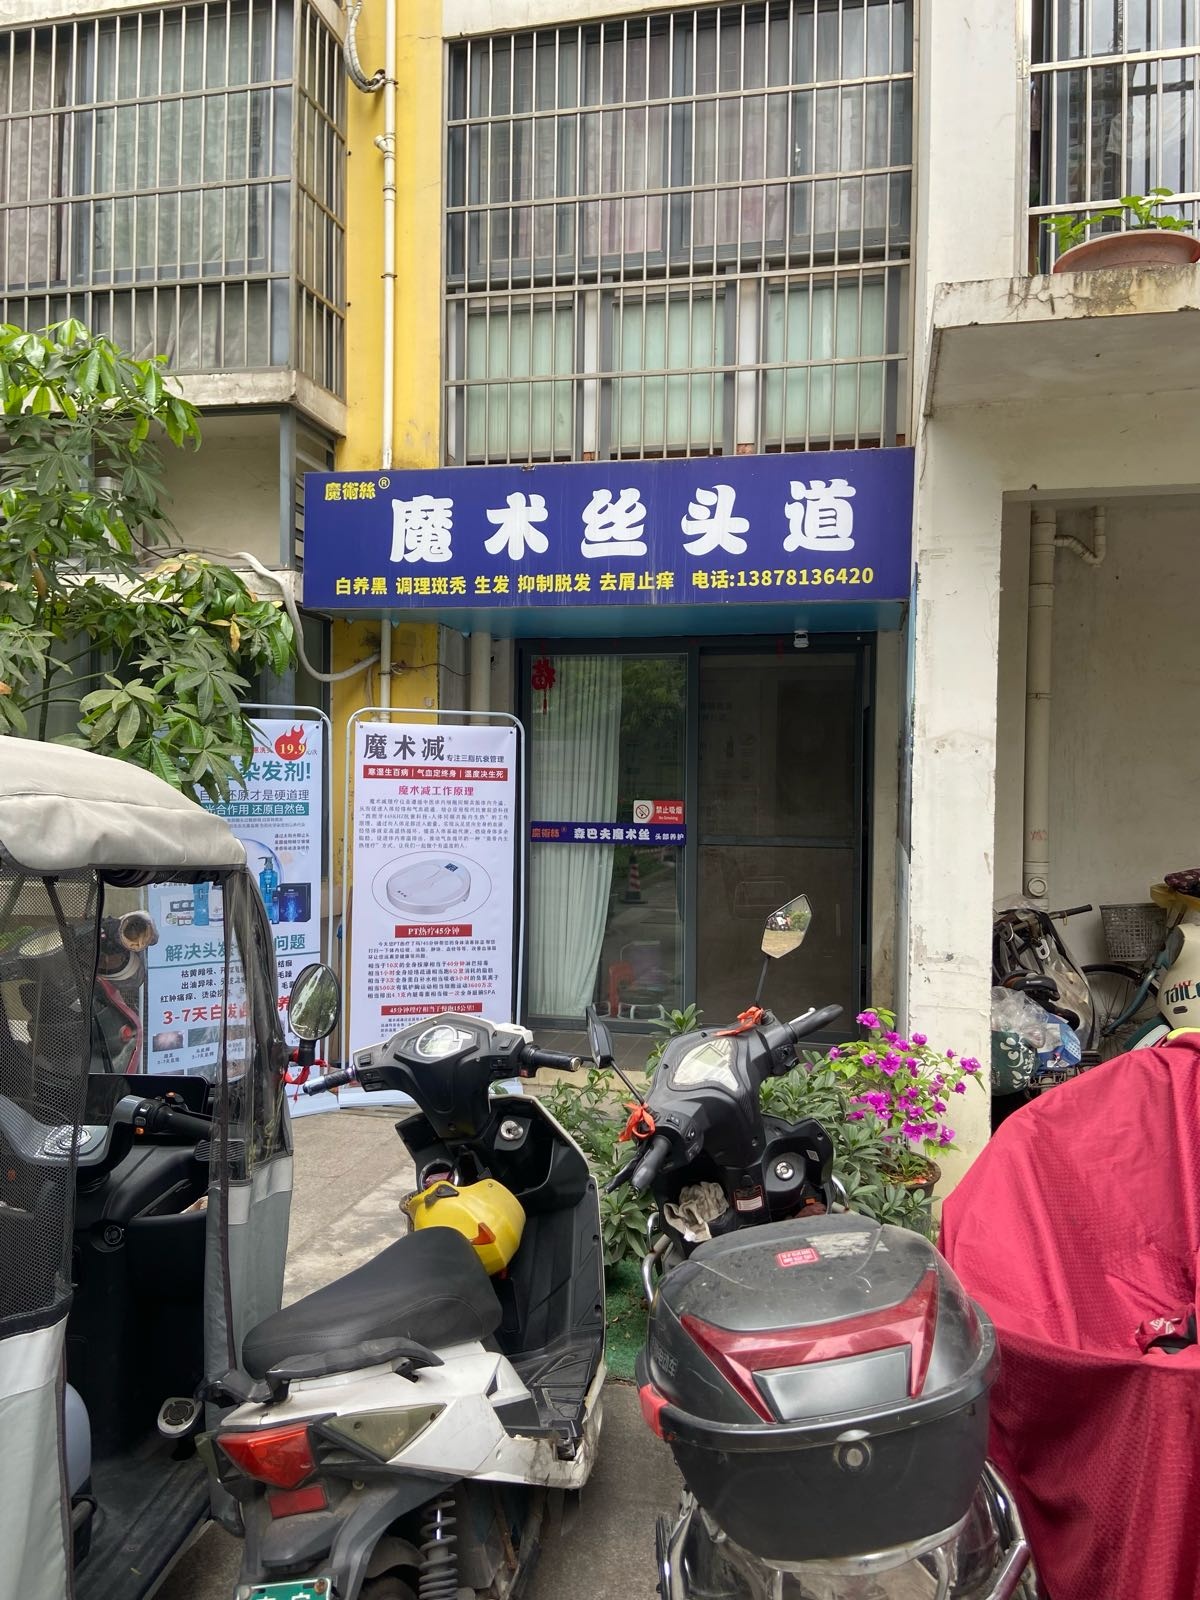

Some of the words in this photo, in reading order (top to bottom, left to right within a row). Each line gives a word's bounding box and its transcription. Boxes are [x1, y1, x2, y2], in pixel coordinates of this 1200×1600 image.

[390, 478, 857, 563] 魔术丝头道
[335, 576, 388, 595] 白养黑
[396, 576, 467, 595] 调理斑秃
[474, 575, 510, 594] 生发
[517, 572, 592, 594] 抑制脱发
[599, 571, 675, 592] 去屑止痒
[691, 566, 875, 589] 电话:13878136420
[280, 742, 306, 756] 19.9
[363, 732, 445, 761] 魔术减
[200, 788, 310, 801] 自还原才是硬道理
[398, 785, 475, 797] 魔术减工作原理
[251, 802, 306, 815] 还原自然色
[274, 934, 306, 952] 问题
